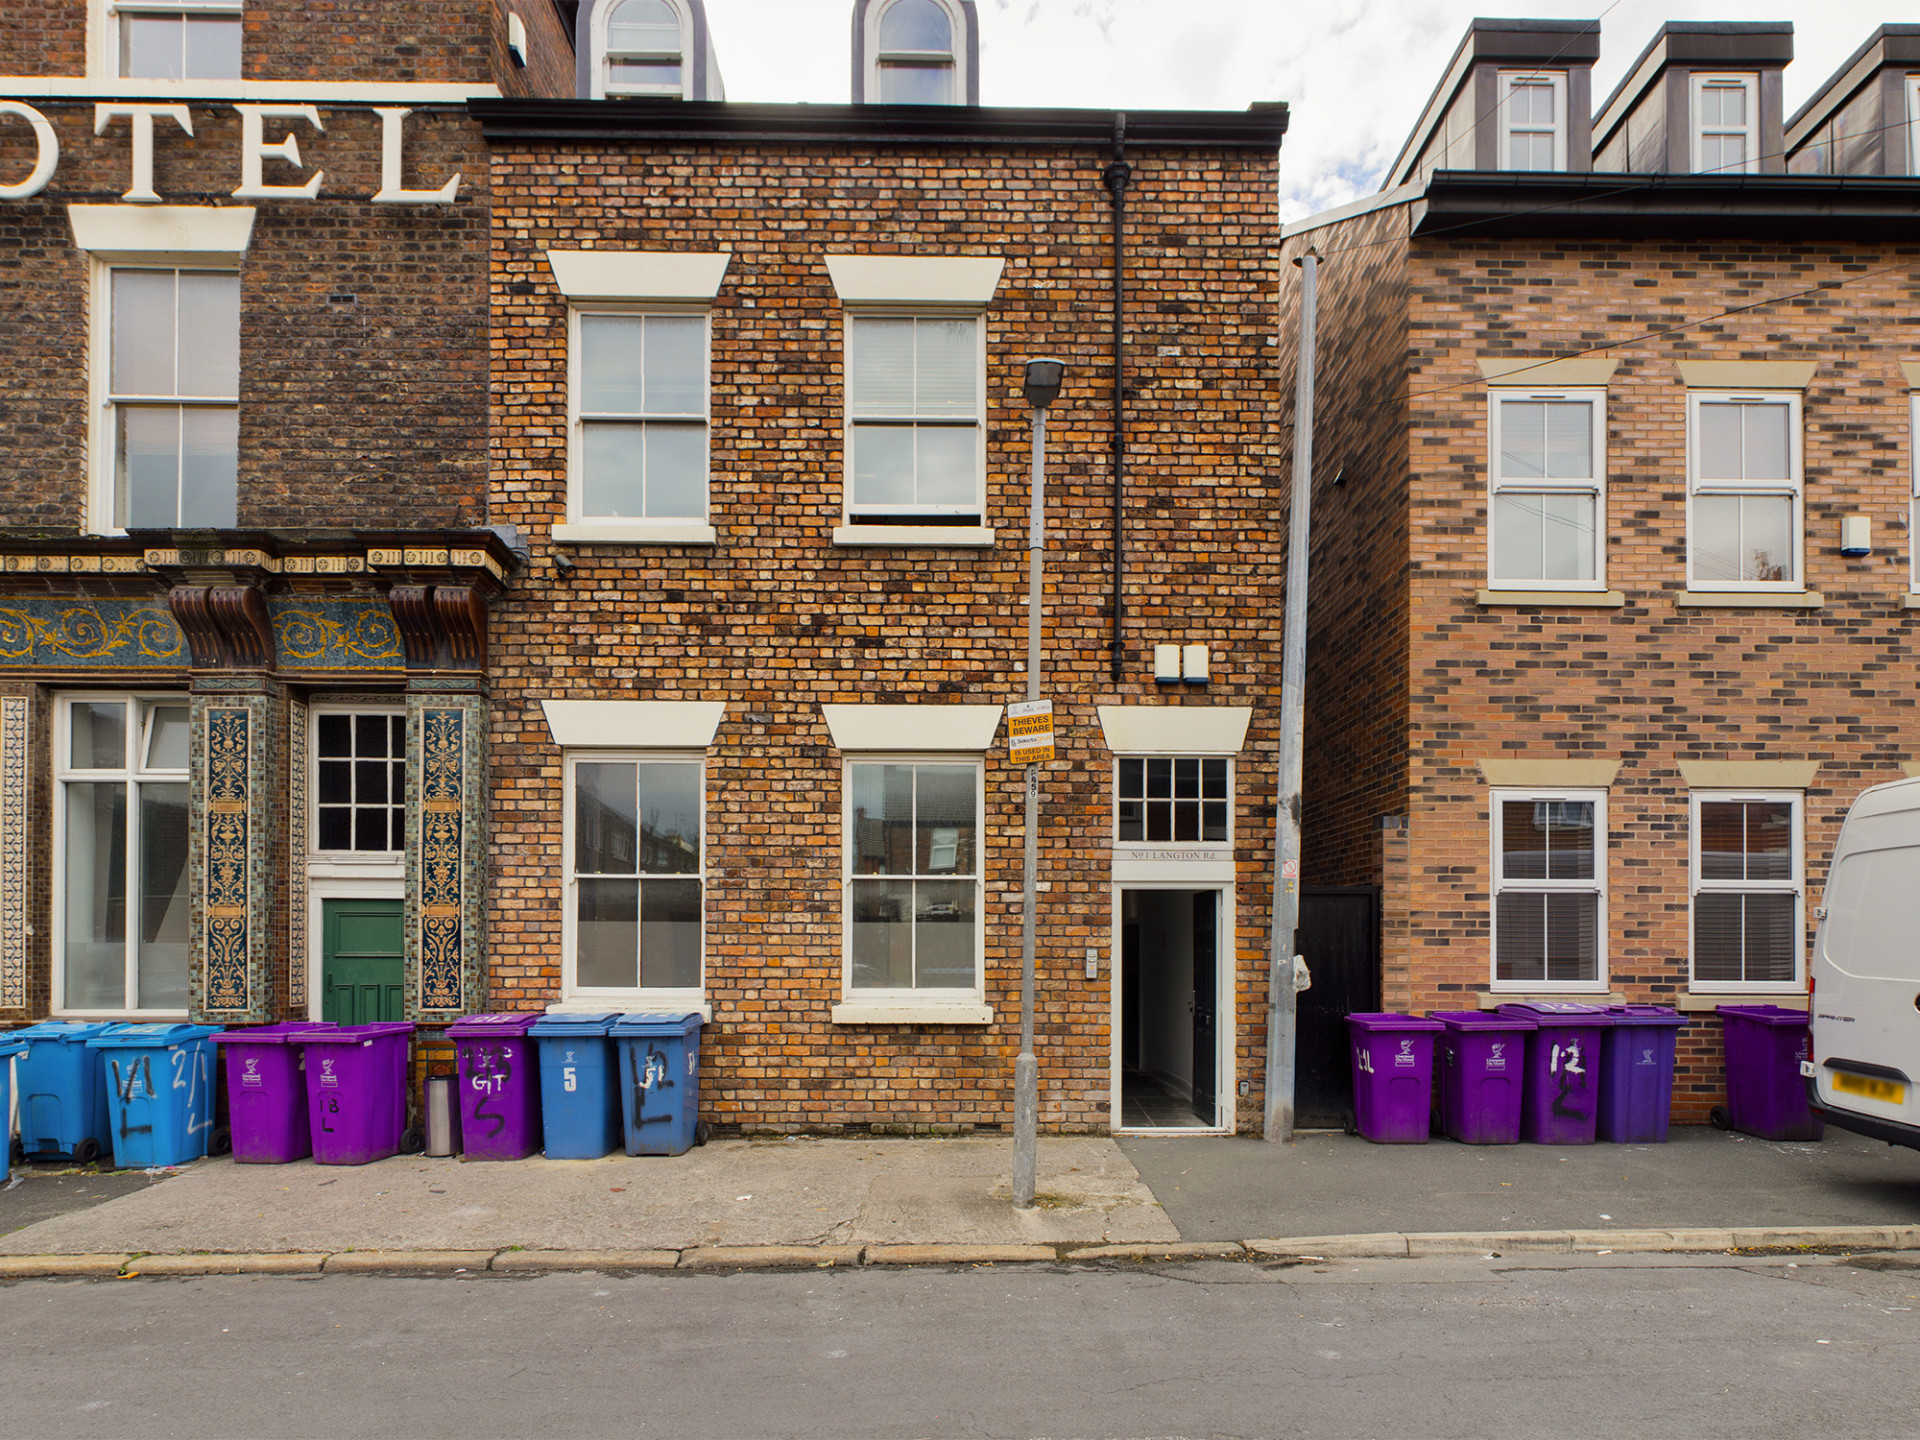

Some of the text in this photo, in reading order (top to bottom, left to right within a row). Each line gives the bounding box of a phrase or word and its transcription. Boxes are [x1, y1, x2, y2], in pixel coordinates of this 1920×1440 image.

[1012, 715, 1049, 726] THIEVES
[1013, 724, 1051, 735] BEWARE
[1022, 747, 1041, 755] USED
[1153, 851, 1200, 859] LANGTON
[563, 1067, 577, 1092] 5
[322, 1117, 335, 1132] L
